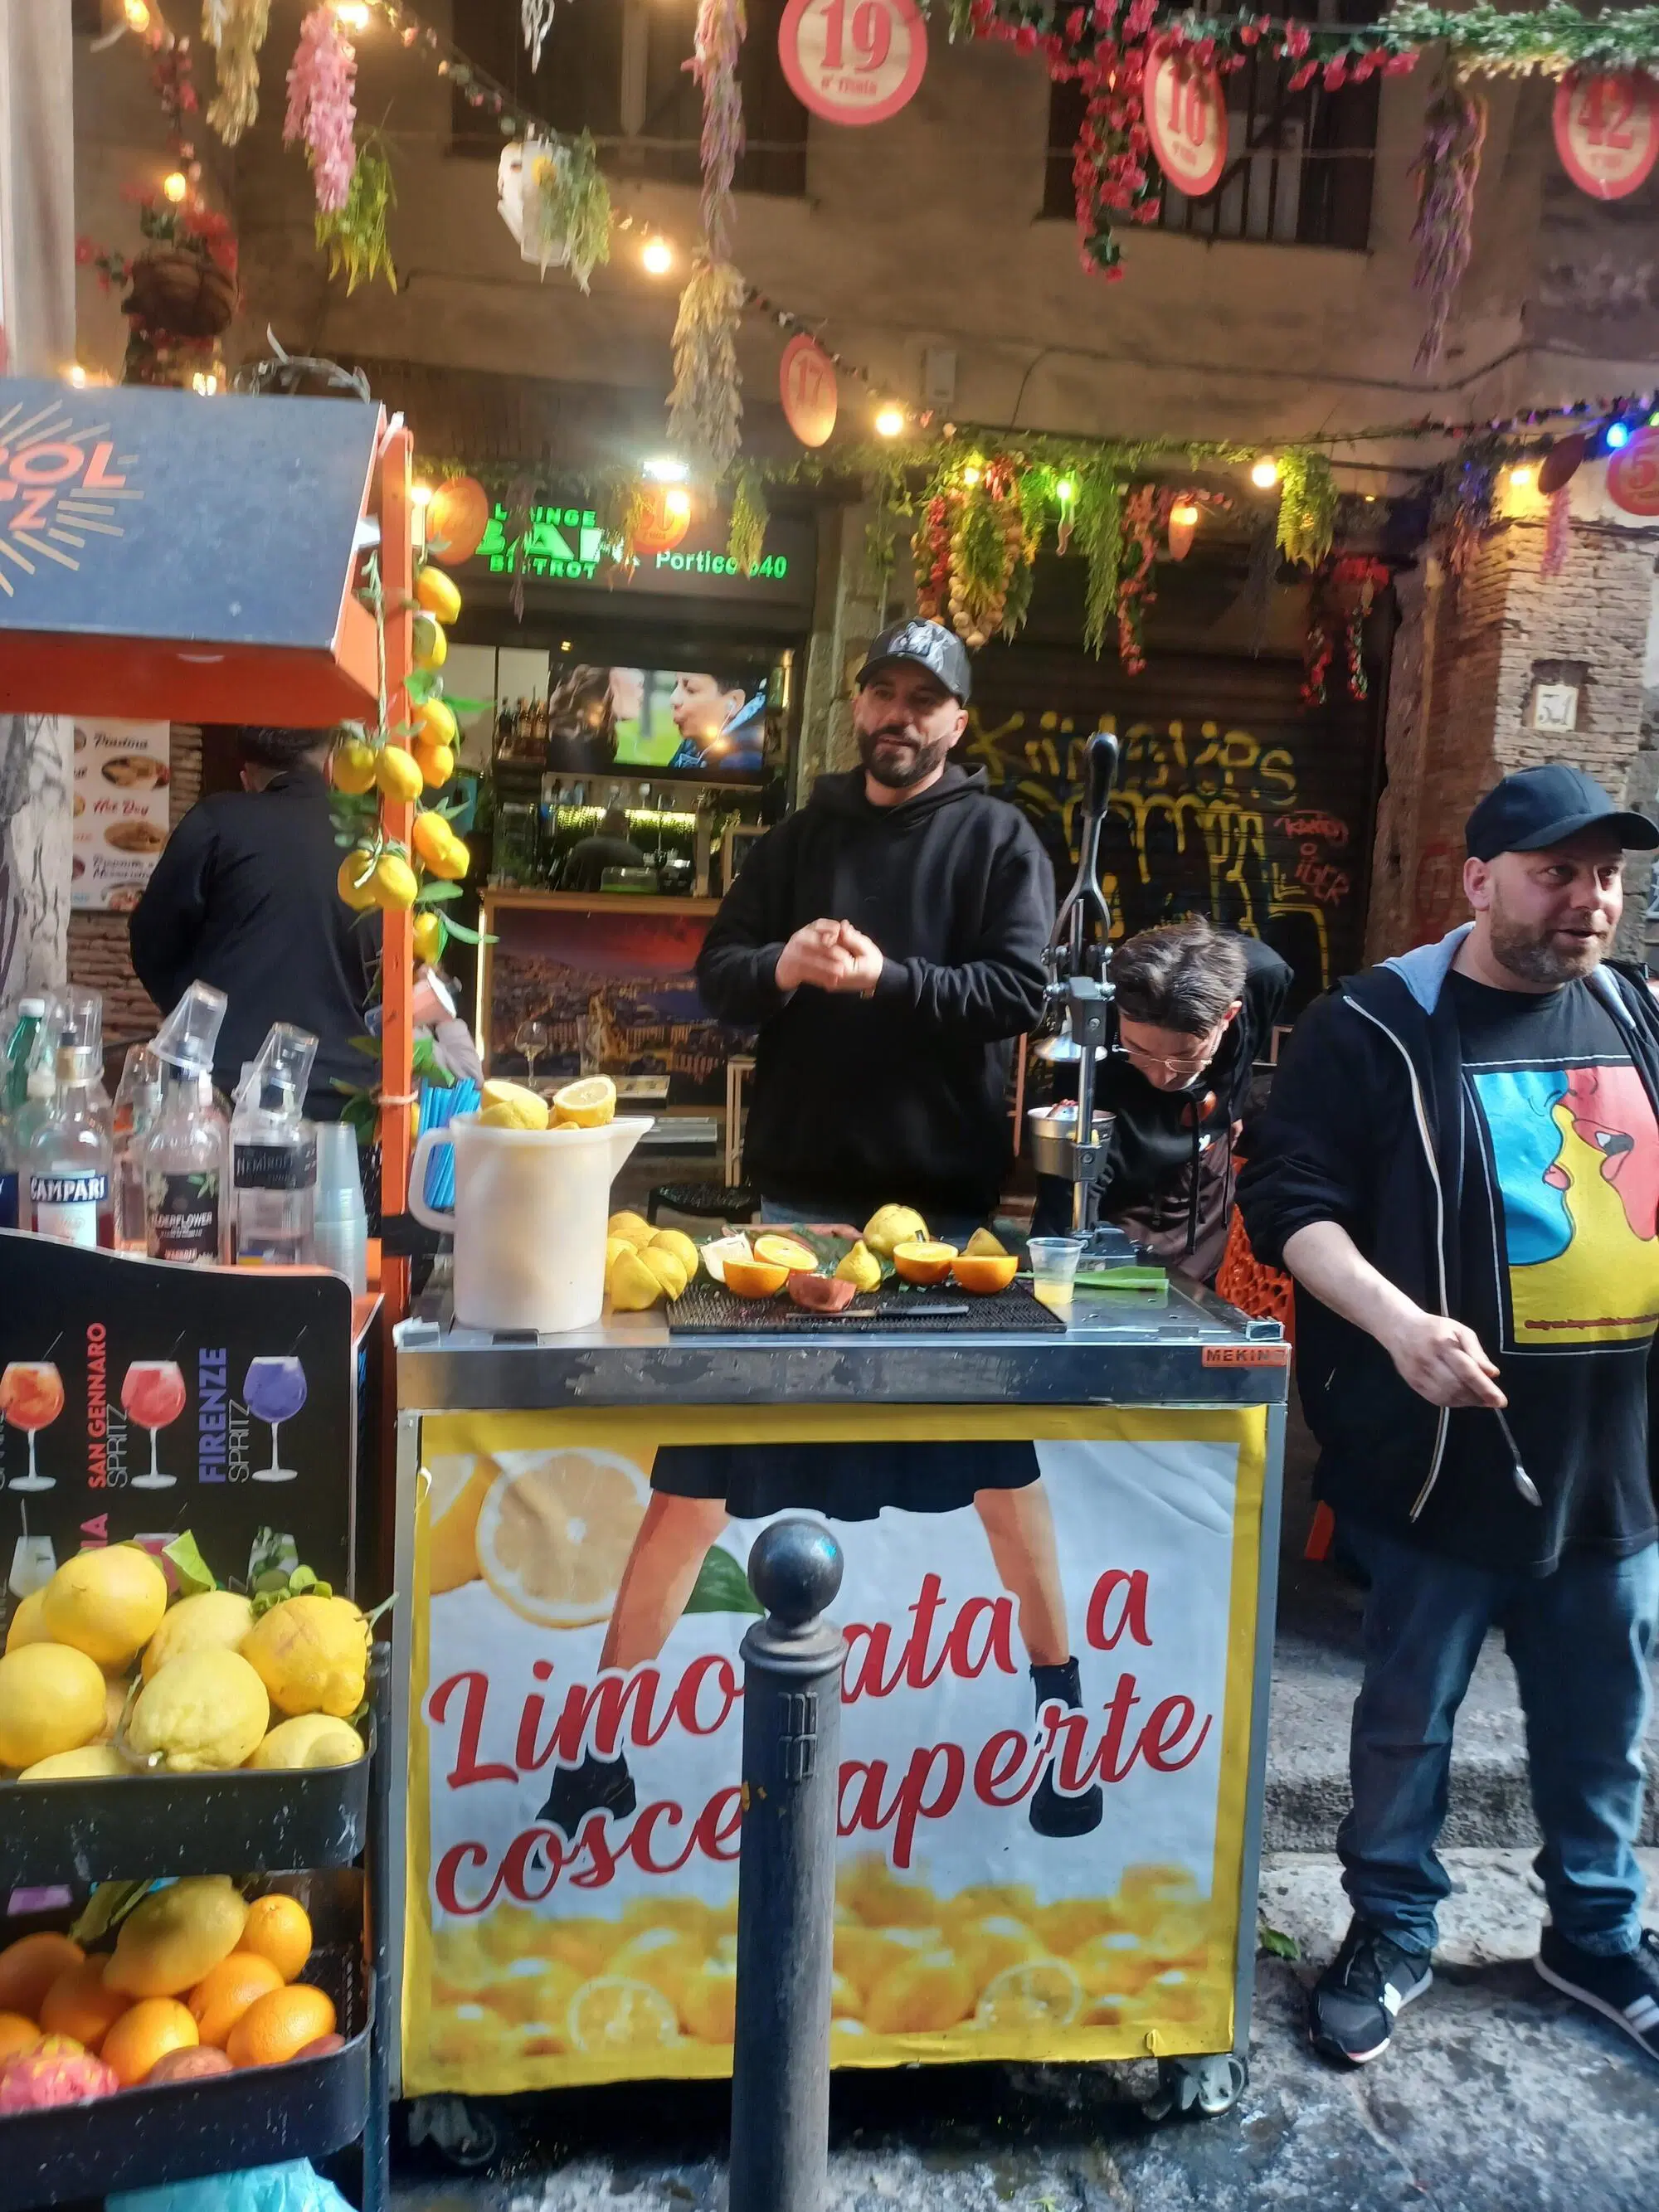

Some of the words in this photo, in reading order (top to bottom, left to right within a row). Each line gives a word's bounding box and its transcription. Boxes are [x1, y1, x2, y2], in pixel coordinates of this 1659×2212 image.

[819, 0, 892, 72] 19
[489, 554, 596, 580] BITROT
[30, 1176, 105, 1201] CAMPARI
[87, 1322, 107, 1438] GENNARO
[198, 1347, 226, 1484] FIRENZE
[87, 1444, 107, 1489] SAN
[106, 1403, 129, 1489] SPRITZ
[228, 1398, 250, 1484] SPRITZ
[1086, 1568, 1153, 1650] a
[435, 1785, 742, 1917] cosce
[836, 1672, 1213, 1869] aperte
